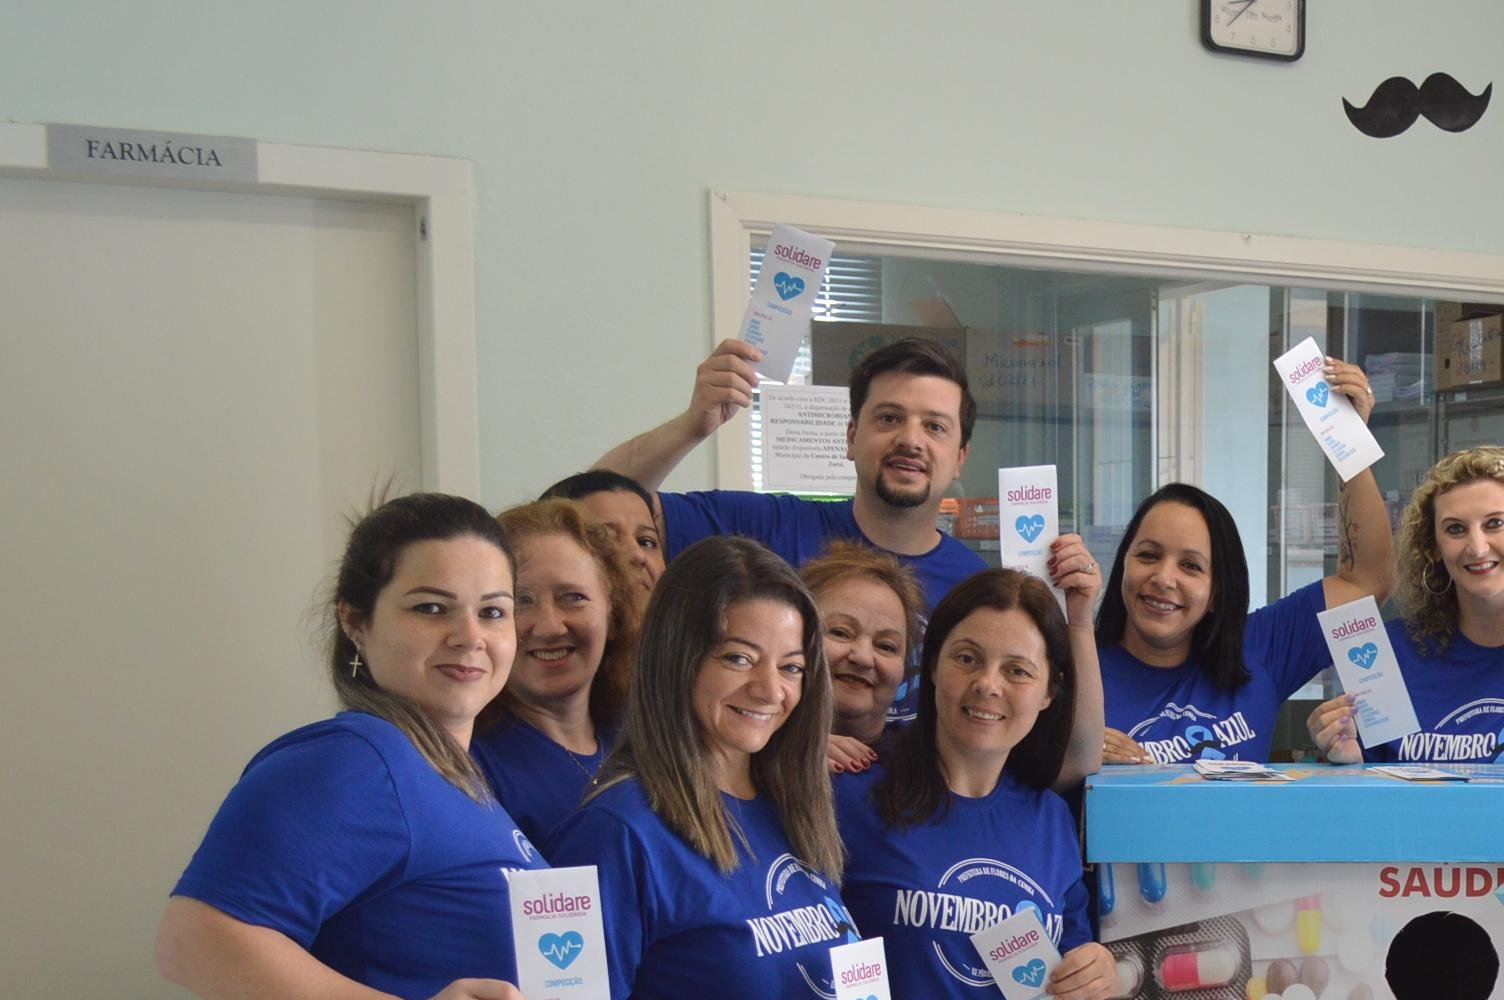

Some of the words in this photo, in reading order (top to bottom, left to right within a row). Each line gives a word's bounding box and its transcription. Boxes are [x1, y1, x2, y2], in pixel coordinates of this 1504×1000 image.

[86, 140, 223, 167] FARMÁCIA
[774, 243, 822, 270] solidare
[1289, 356, 1322, 384] solidare
[1007, 485, 1052, 502] solidare
[1331, 616, 1377, 640] solidare
[1212, 711, 1256, 748] AZUL
[1398, 732, 1496, 761] NOVEMBRO
[523, 893, 592, 915] solidare
[745, 903, 841, 957] NOVEMBRO
[989, 929, 1040, 962] solidare
[841, 962, 882, 985] solidare
